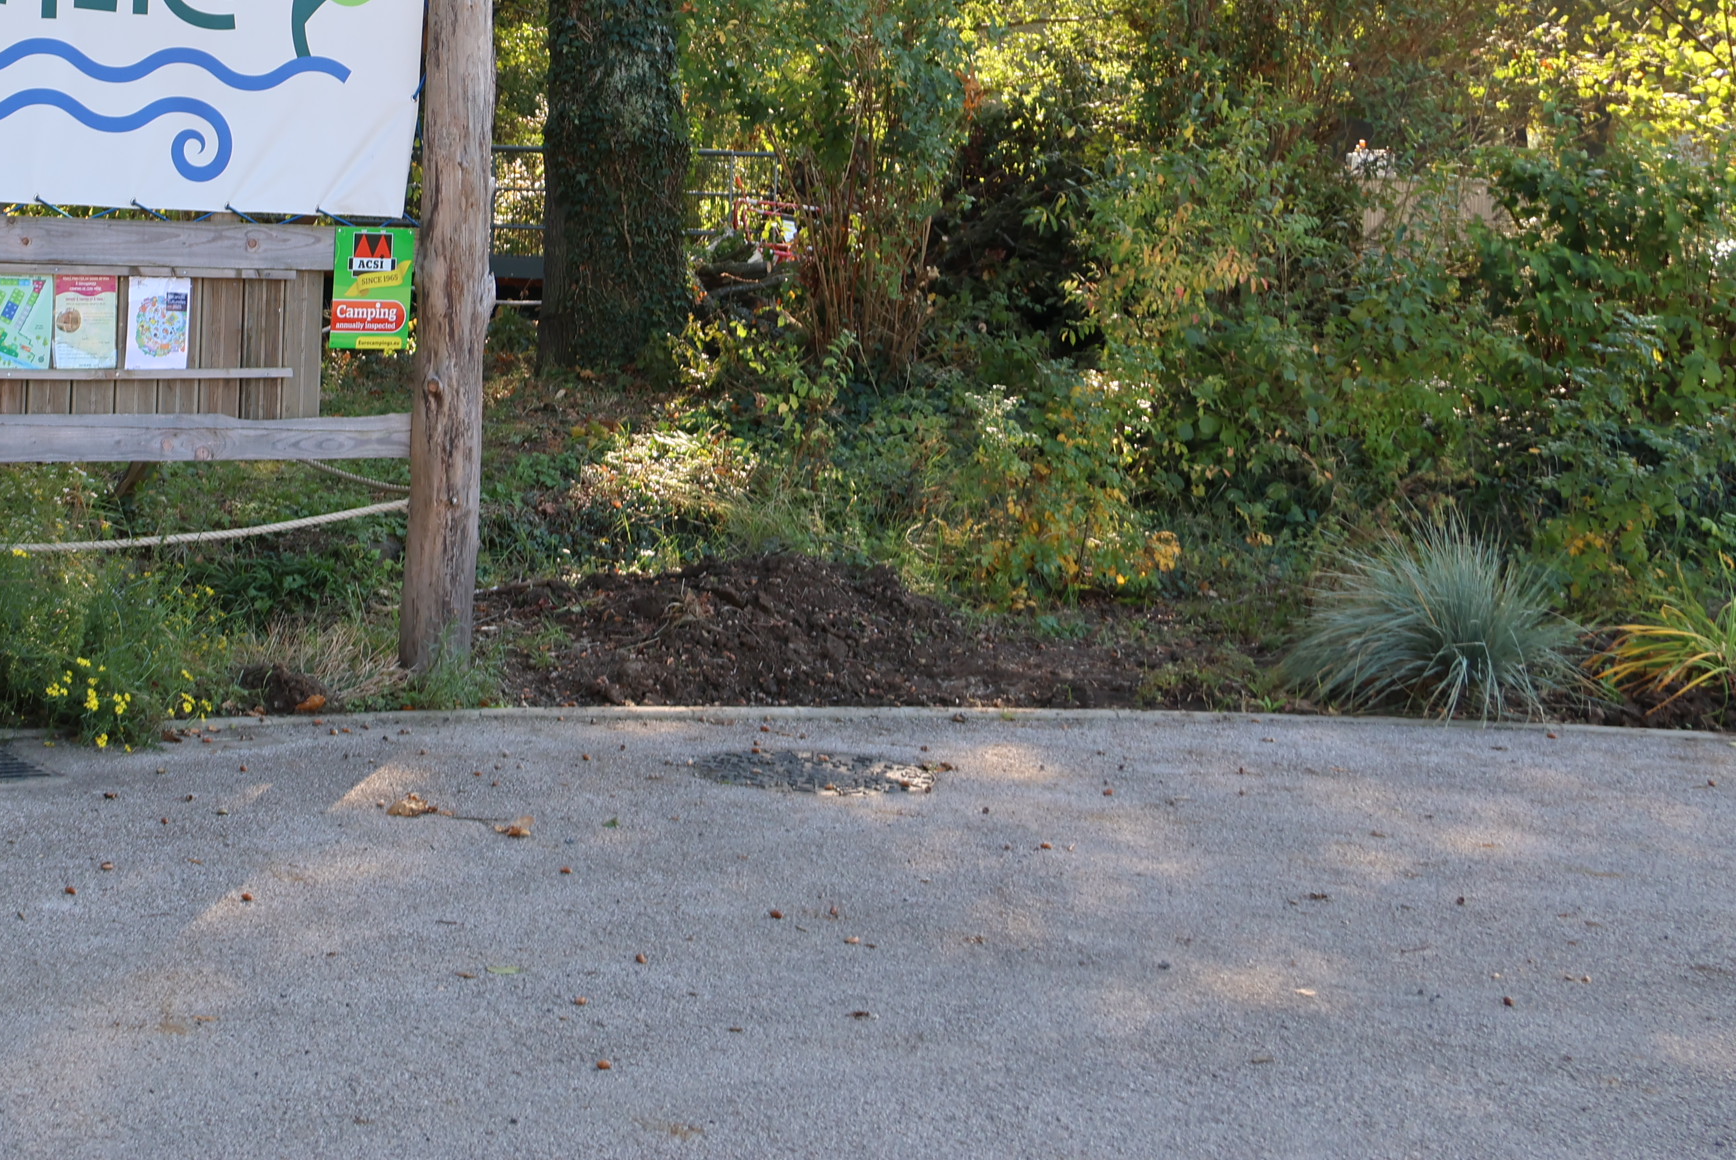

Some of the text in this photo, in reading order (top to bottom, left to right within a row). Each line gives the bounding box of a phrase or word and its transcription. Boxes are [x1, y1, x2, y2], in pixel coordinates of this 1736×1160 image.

[358, 259, 384, 269] ACSI
[361, 273, 399, 285] SINCE 1965
[336, 301, 397, 321] Camping
[336, 321, 396, 330] annually inspected
